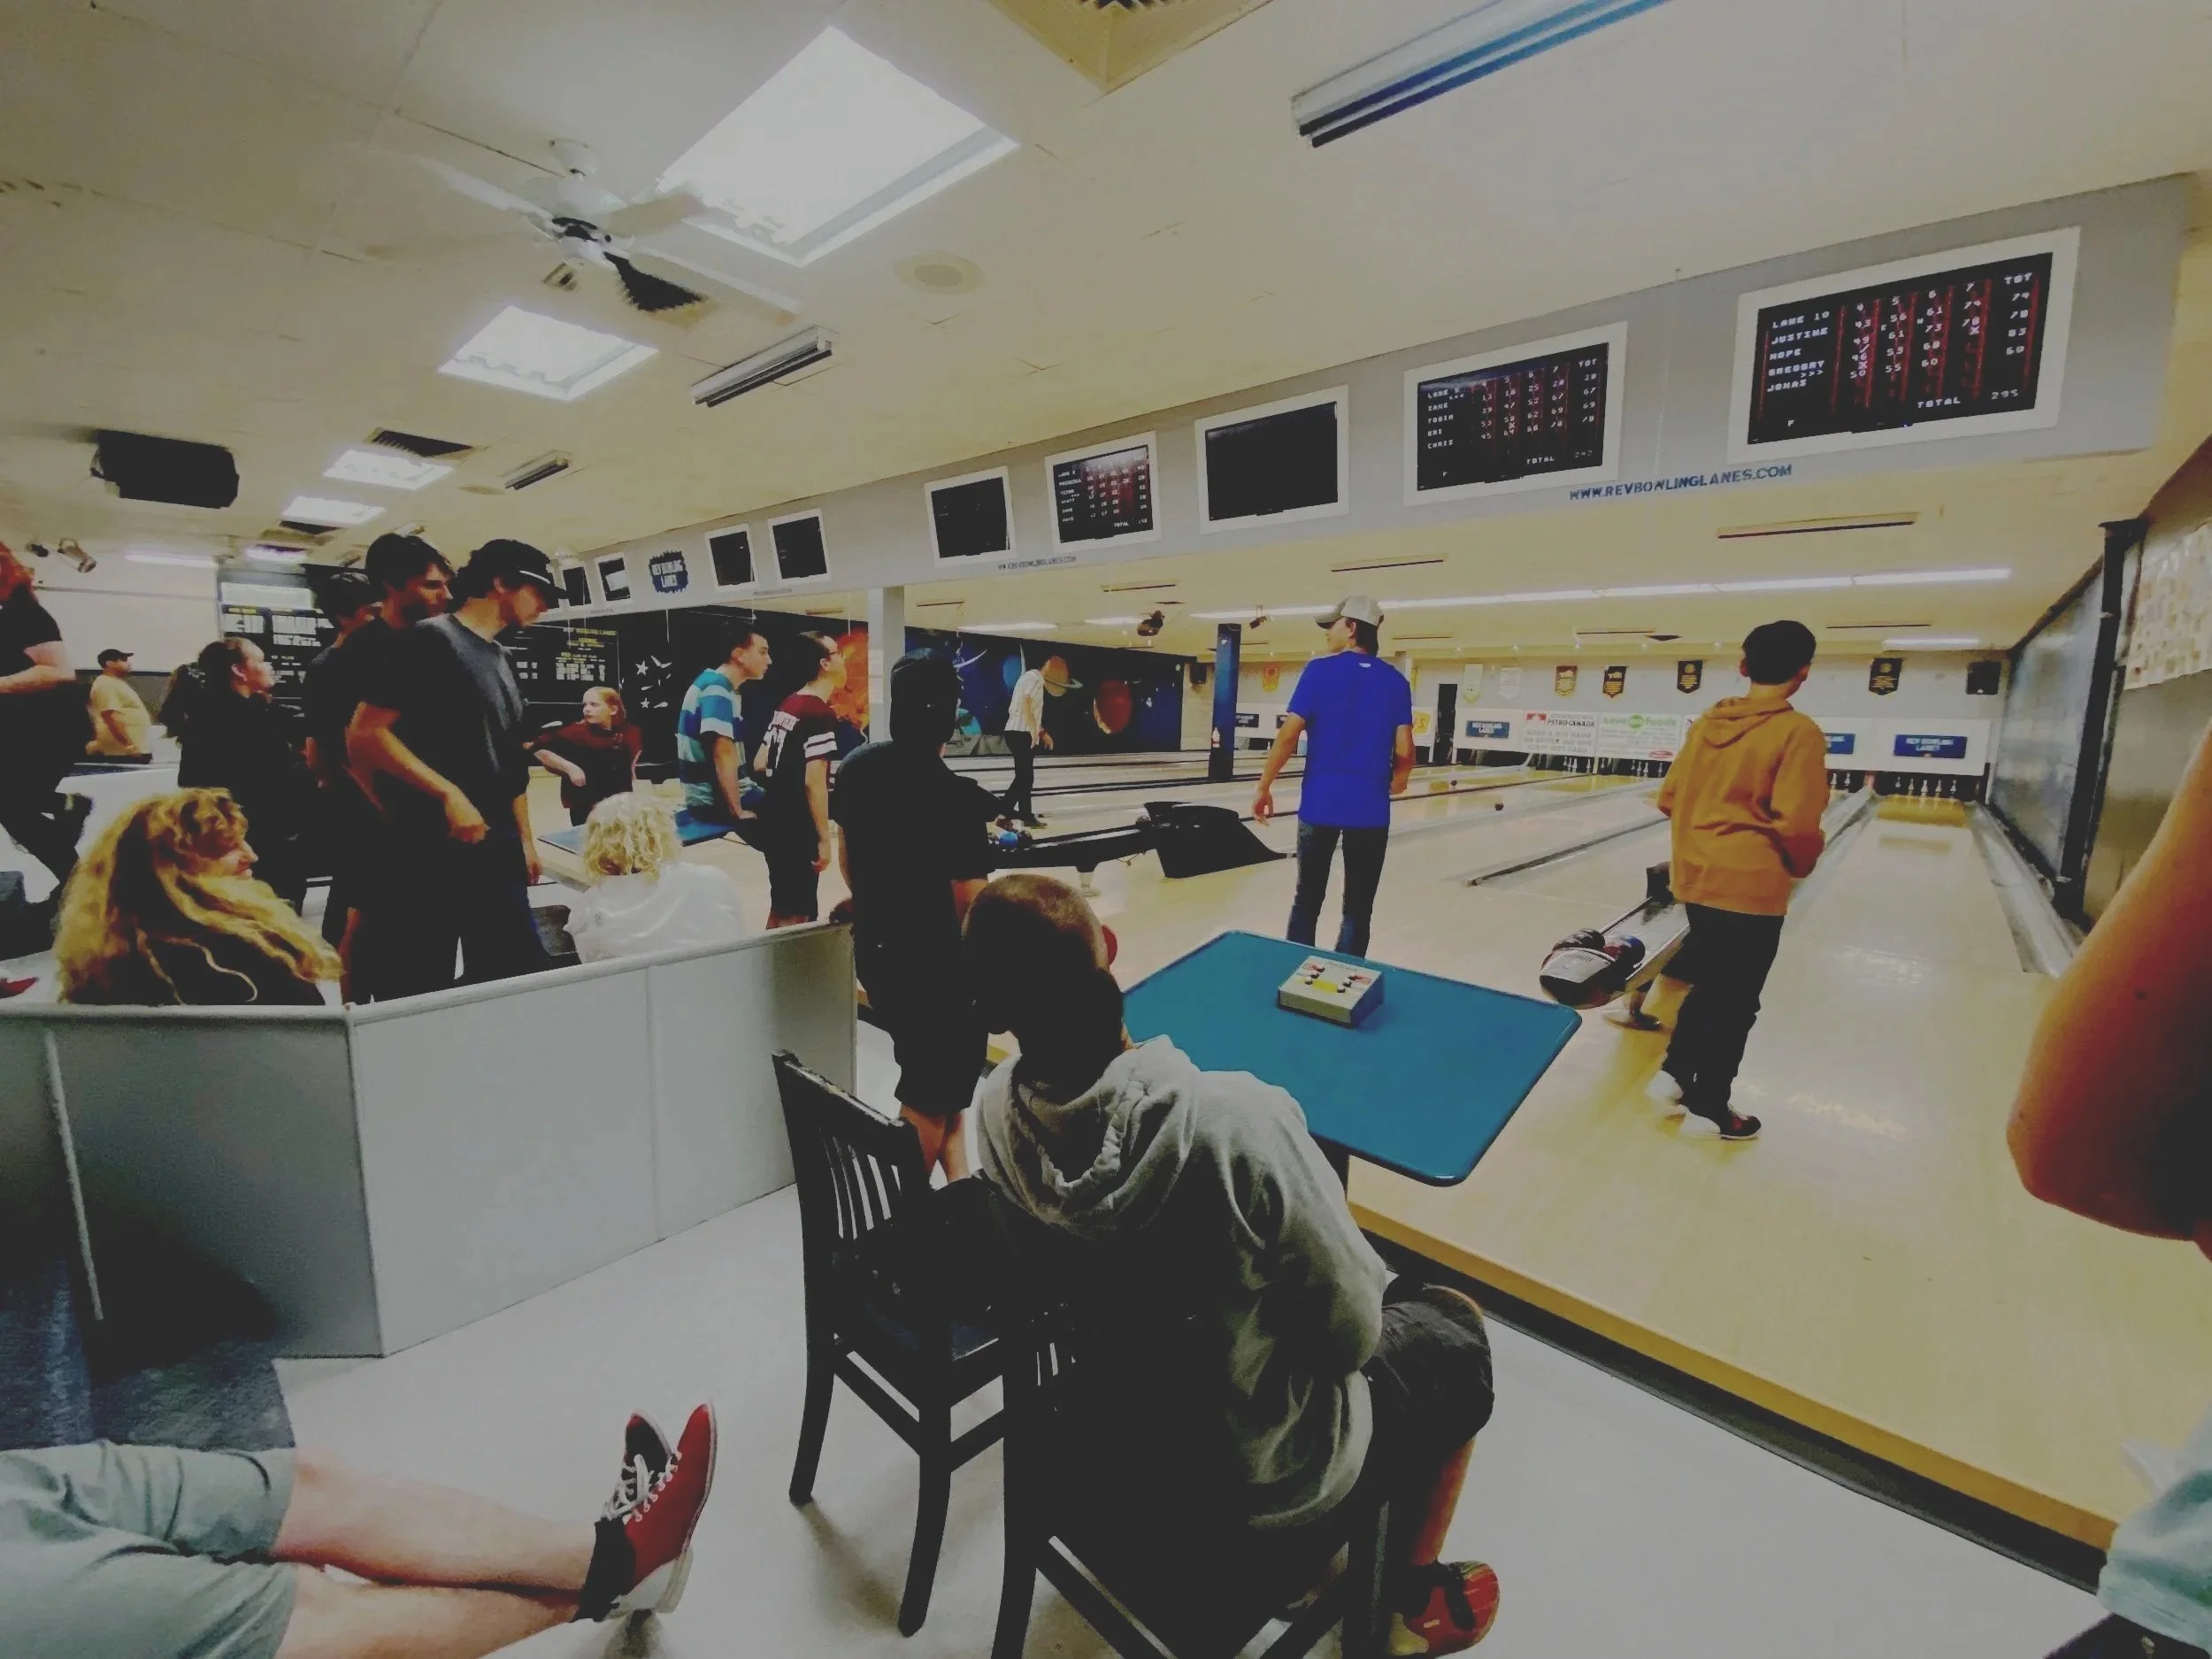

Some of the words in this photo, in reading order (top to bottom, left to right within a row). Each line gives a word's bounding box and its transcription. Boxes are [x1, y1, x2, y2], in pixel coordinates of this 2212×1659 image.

[1772, 315, 1805, 328] LANE
[1815, 311, 1830, 320] 10
[1892, 296, 1901, 305] 5
[2004, 273, 2032, 284] TOT
[1771, 327, 1828, 344] JUSTINE
[1578, 358, 1597, 367] TOT
[1770, 349, 1801, 360] HOPE
[1768, 360, 1824, 376] GREGORY
[1767, 380, 1807, 392] JONAS
[1917, 396, 1961, 408] TOTAL
[1991, 389, 2018, 400] 295
[1526, 456, 1555, 465] TOTAL
[1570, 465, 1793, 500] WWW.REVBOWLINGLANES.COM
